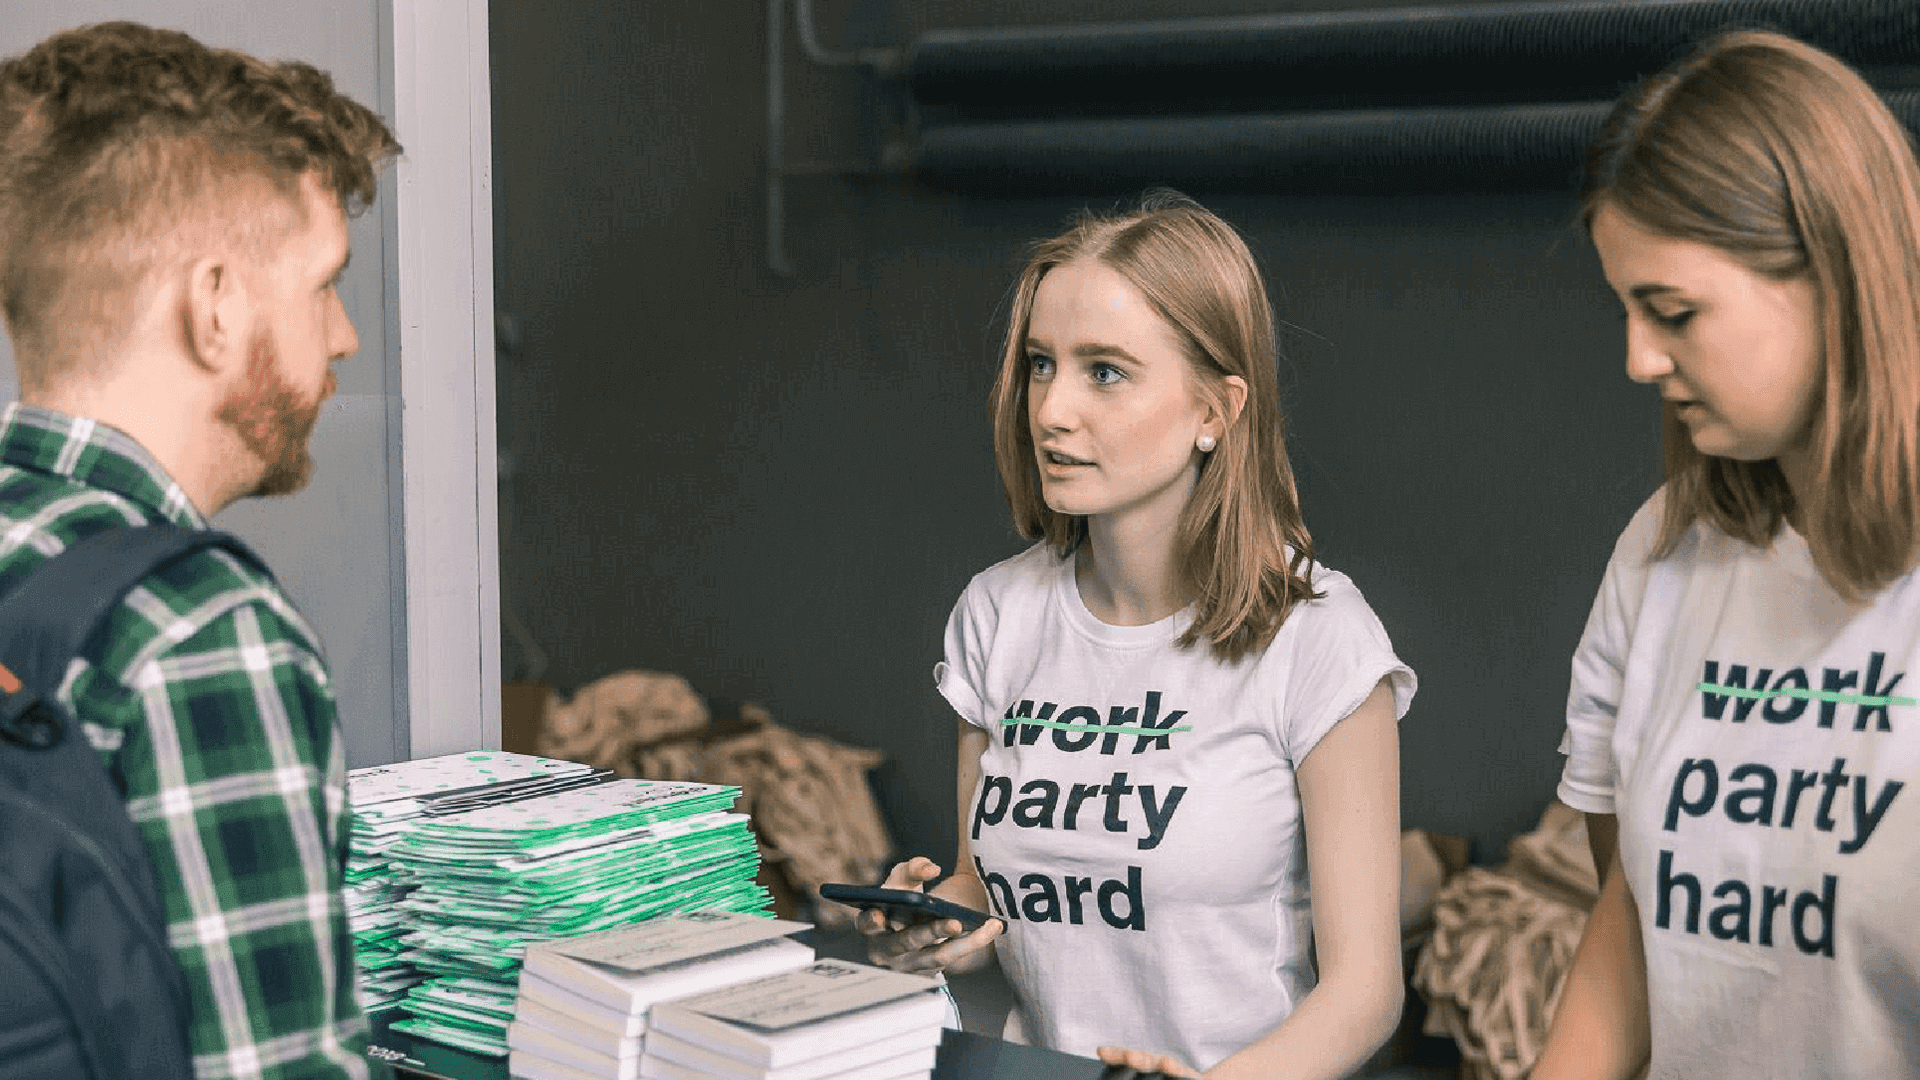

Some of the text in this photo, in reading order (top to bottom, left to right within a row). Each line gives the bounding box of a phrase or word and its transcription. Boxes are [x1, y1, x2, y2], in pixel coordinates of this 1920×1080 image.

[1003, 690, 1188, 755] work
[1701, 651, 1905, 732] work
[971, 772, 1188, 850] party
[1661, 757, 1904, 854] party
[971, 854, 1146, 931] hard
[1655, 849, 1839, 960] hard
